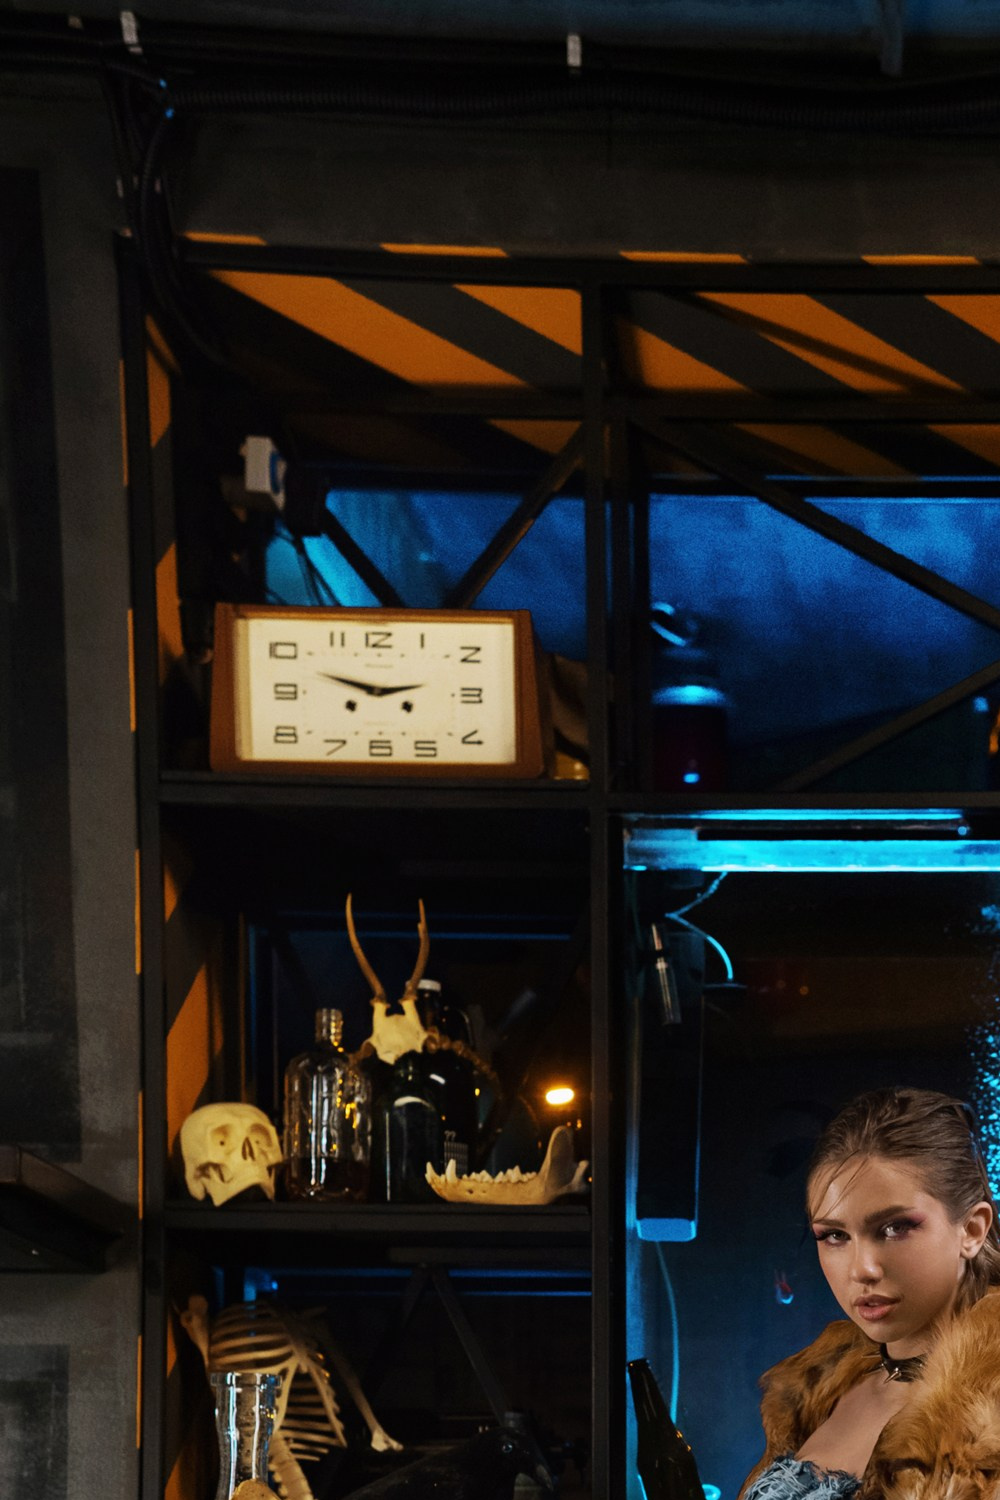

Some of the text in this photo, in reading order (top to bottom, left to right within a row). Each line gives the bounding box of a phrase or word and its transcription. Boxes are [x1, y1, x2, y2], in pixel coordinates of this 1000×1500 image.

[330, 631, 345, 647] 11
[365, 632, 393, 648] 12
[269, 642, 297, 659] 10
[460, 646, 481, 663] 2
[274, 684, 297, 700] 9
[460, 688, 483, 704] 3
[274, 726, 298, 744] 8
[461, 730, 484, 745] 4
[323, 739, 347, 756] 7
[369, 740, 393, 757] 6
[414, 740, 437, 758] 5
